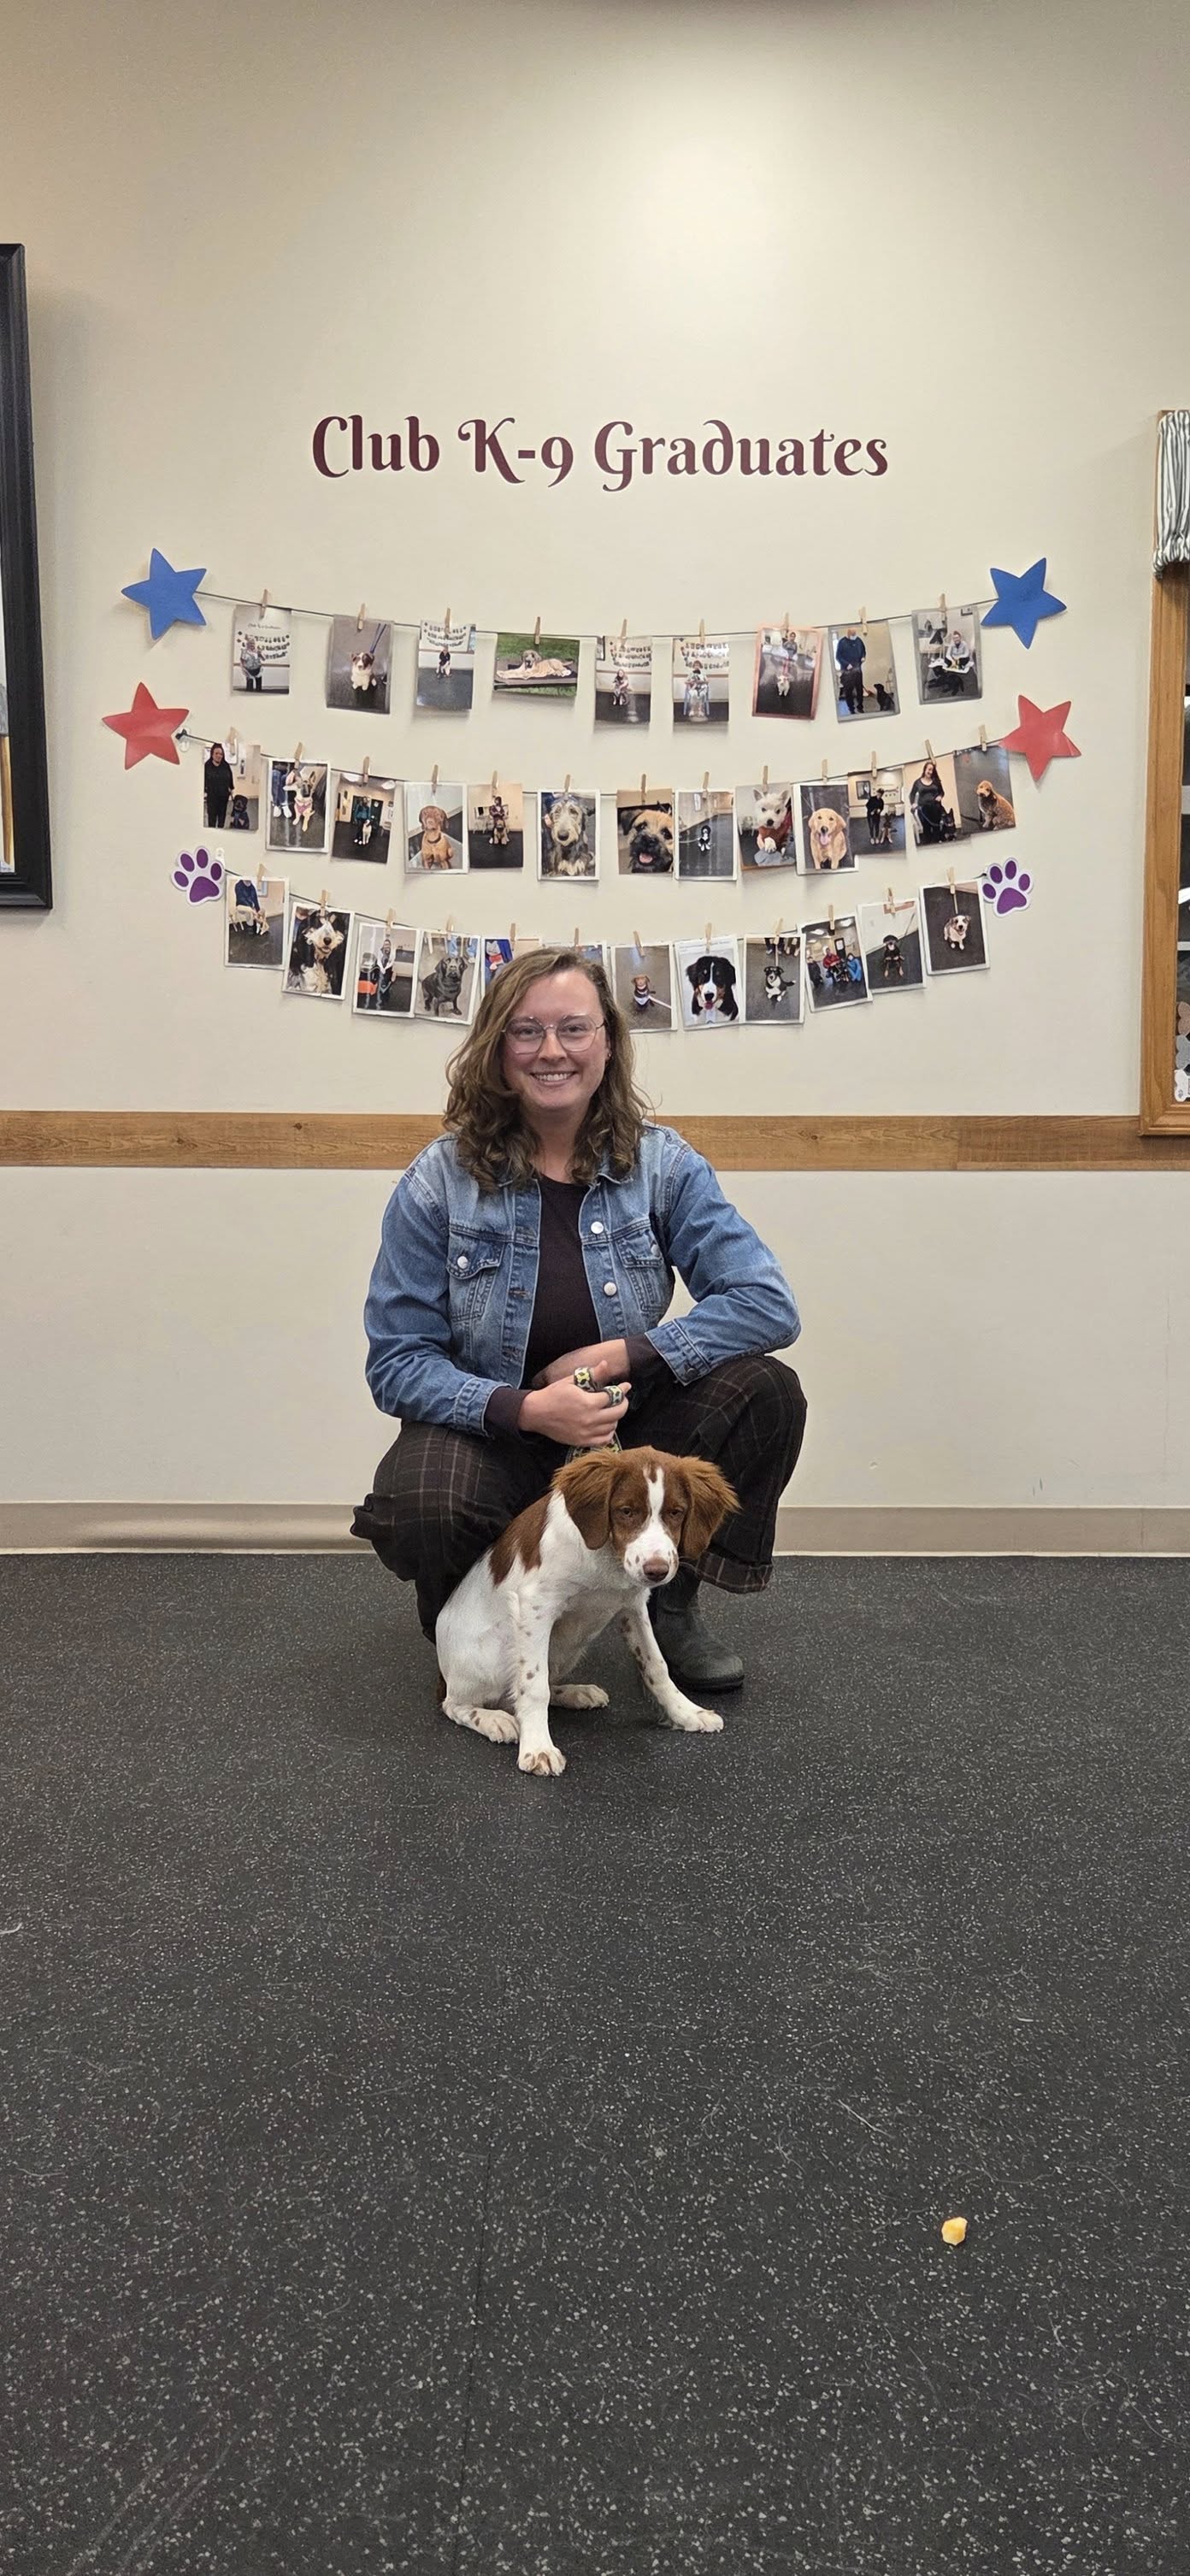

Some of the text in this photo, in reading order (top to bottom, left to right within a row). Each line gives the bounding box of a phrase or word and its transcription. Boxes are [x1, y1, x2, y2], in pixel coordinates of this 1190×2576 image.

[313, 415, 888, 492] Club K-9 Graduates
